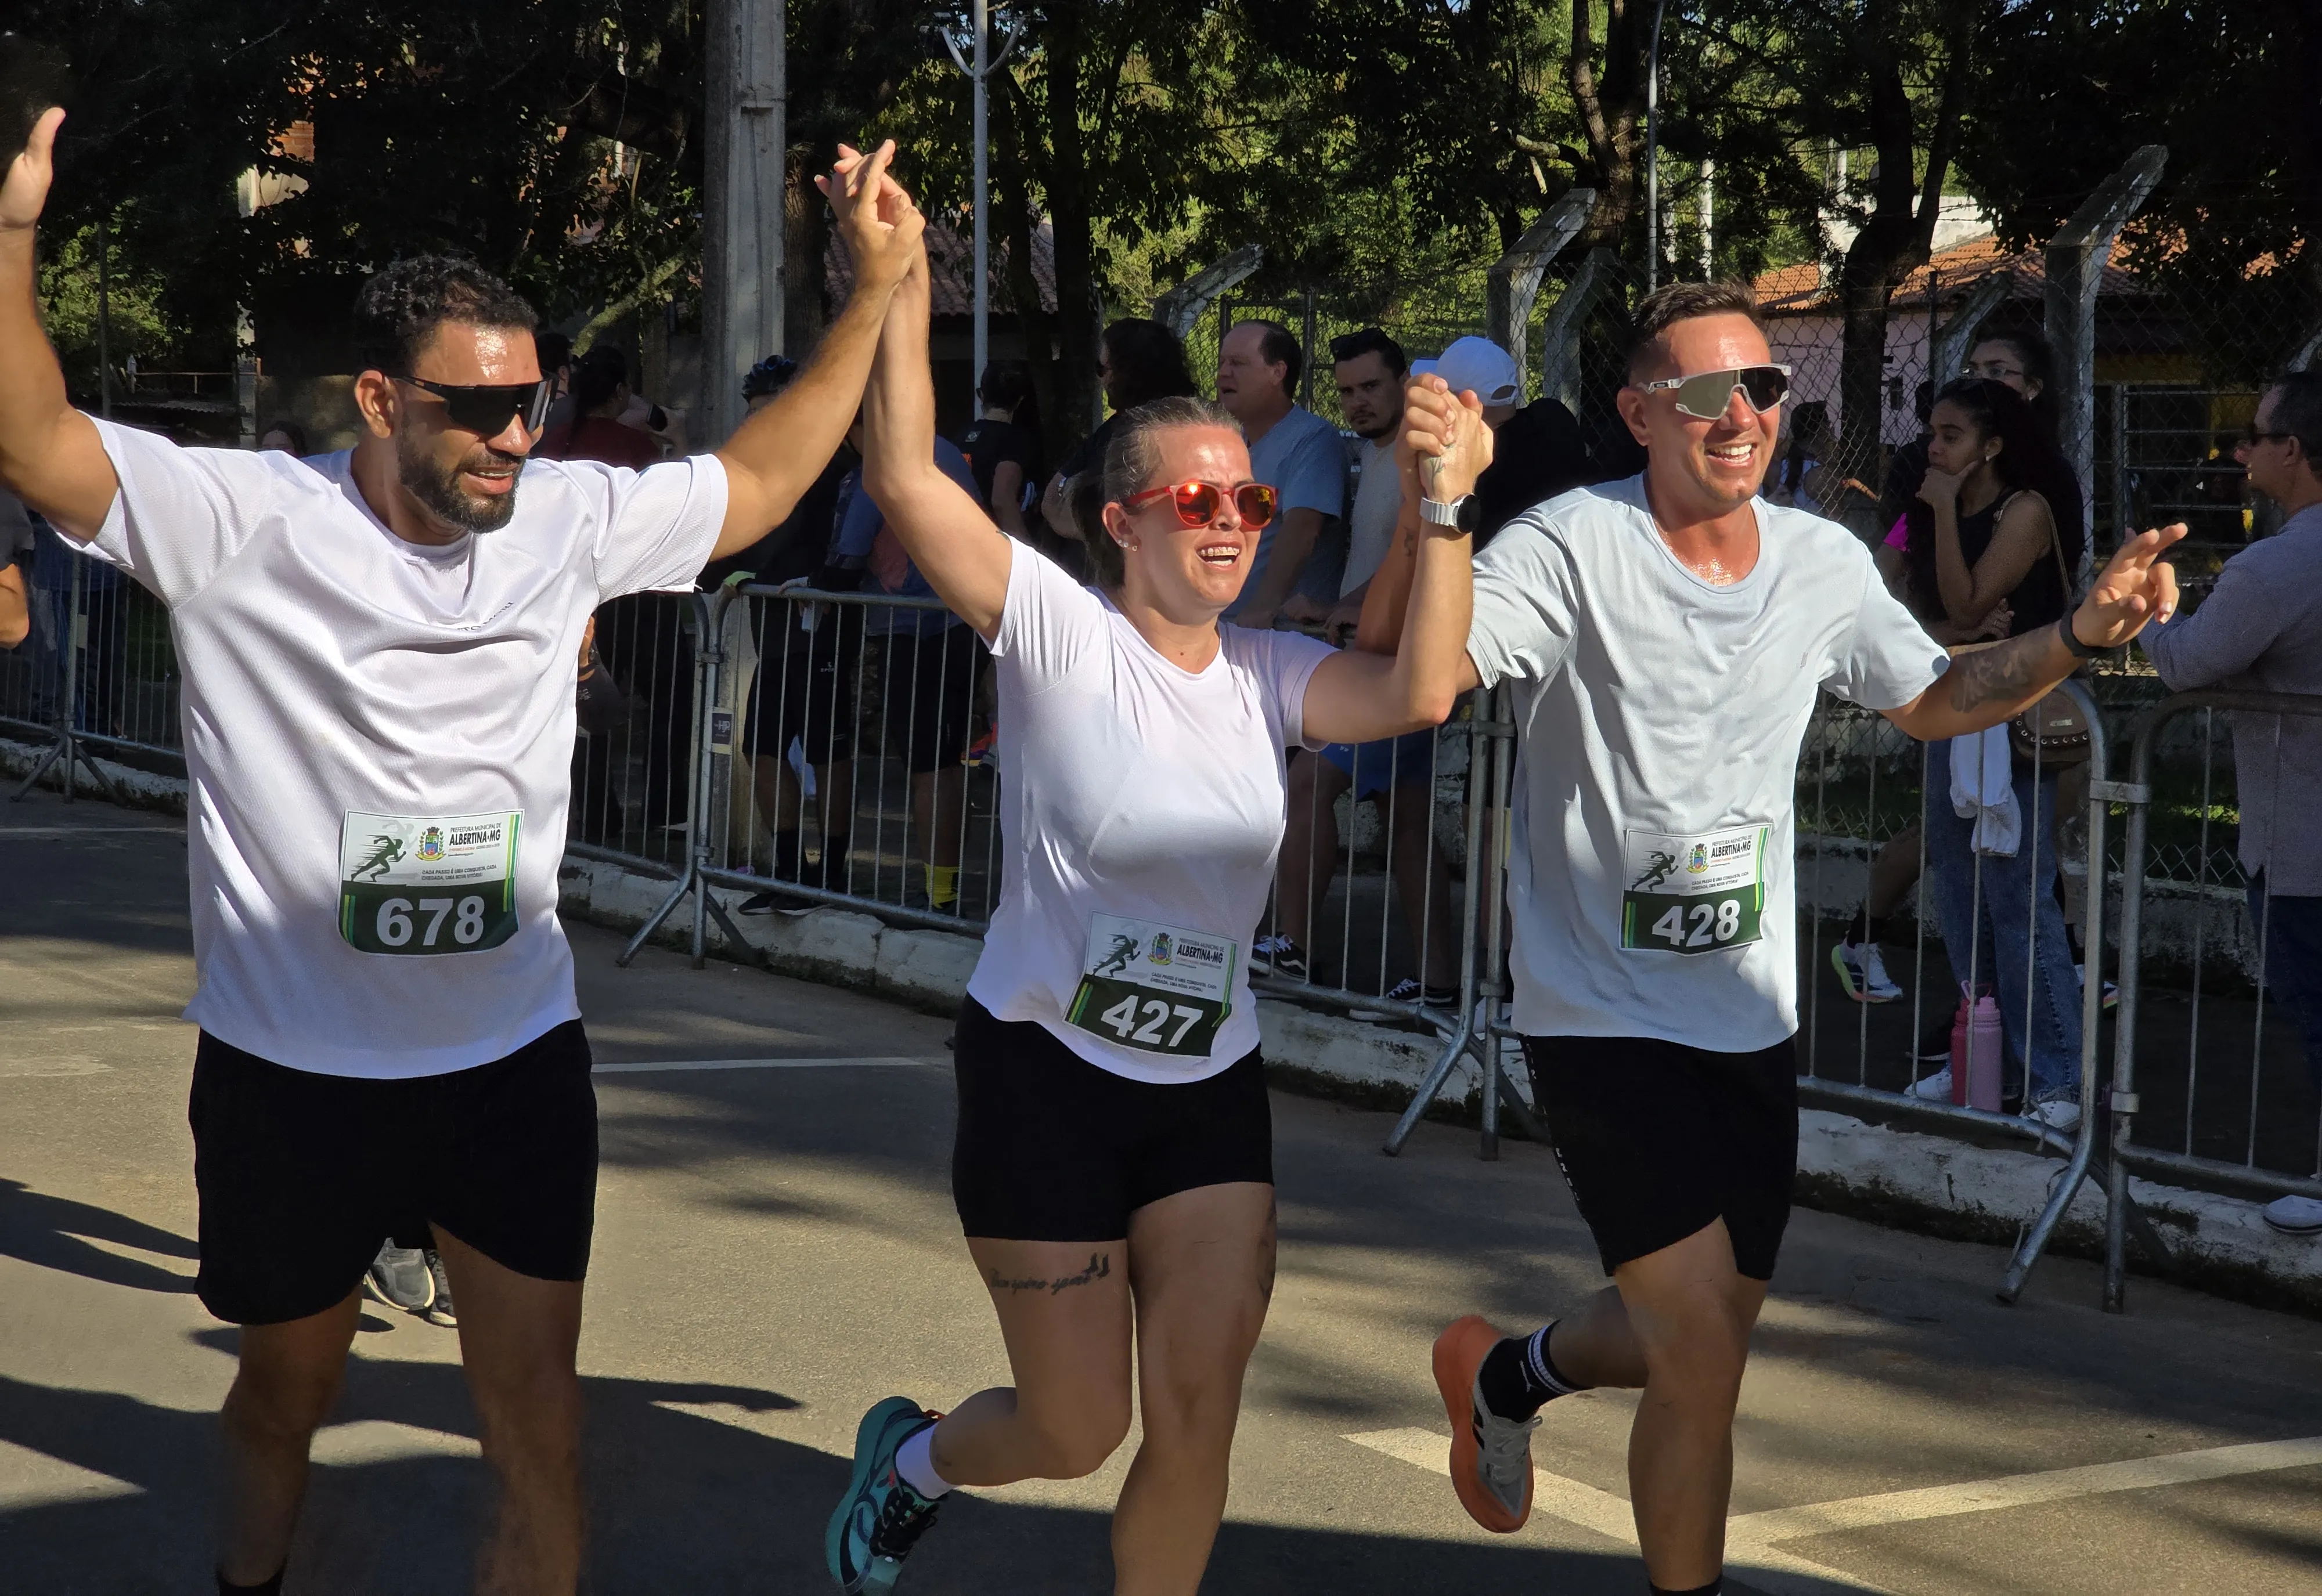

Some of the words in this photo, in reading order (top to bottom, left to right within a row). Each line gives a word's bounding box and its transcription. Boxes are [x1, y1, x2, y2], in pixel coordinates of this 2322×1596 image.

[377, 896, 485, 946] 678
[1652, 900, 1740, 947] 428
[1101, 995, 1203, 1047] 427
